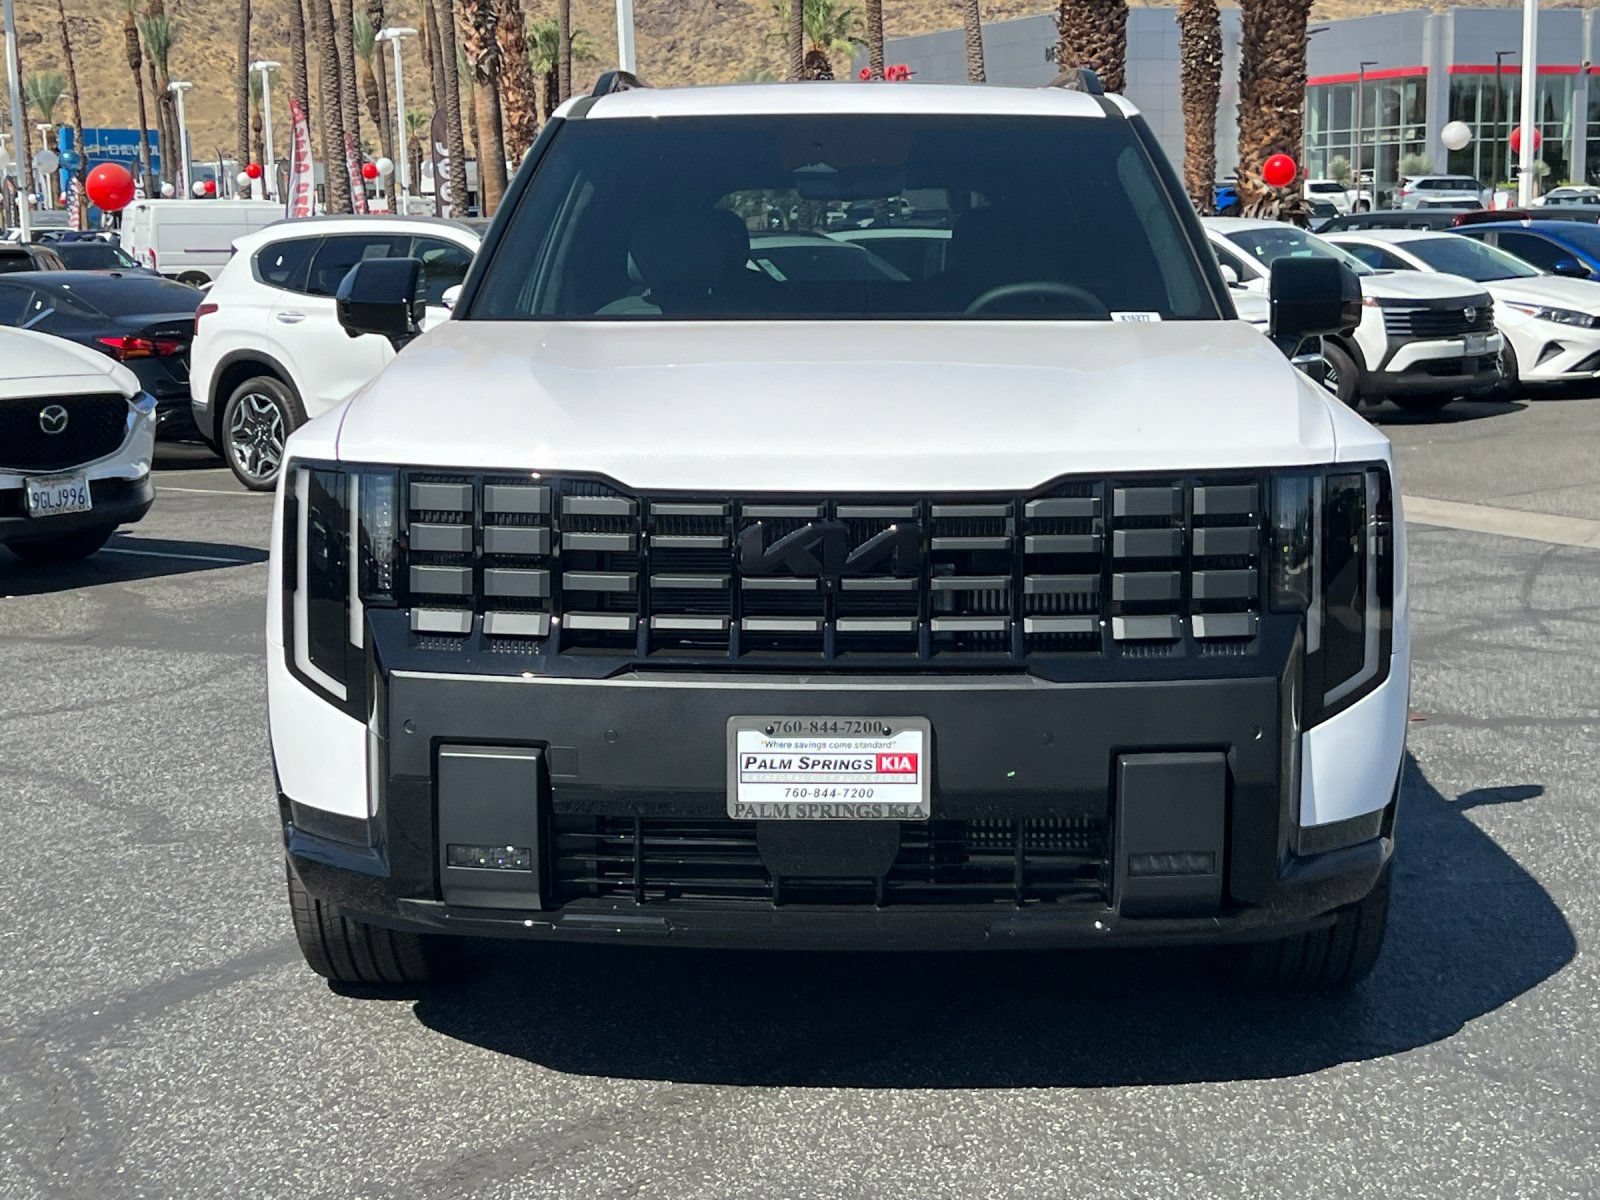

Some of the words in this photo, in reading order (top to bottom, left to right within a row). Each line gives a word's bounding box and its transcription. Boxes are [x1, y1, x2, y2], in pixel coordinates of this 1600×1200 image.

[33, 486, 85, 510] 9GLJ996
[773, 720, 883, 734] 760-844-7200
[794, 741, 827, 751] savings
[829, 741, 852, 749] come
[744, 756, 792, 770] PALM
[797, 756, 874, 771] SPRINGS
[882, 757, 912, 771] KIA
[785, 788, 874, 798] 760-844-7200
[735, 803, 792, 818] PALM
[796, 803, 882, 819] SPRINGS
[887, 803, 928, 819] KIA
